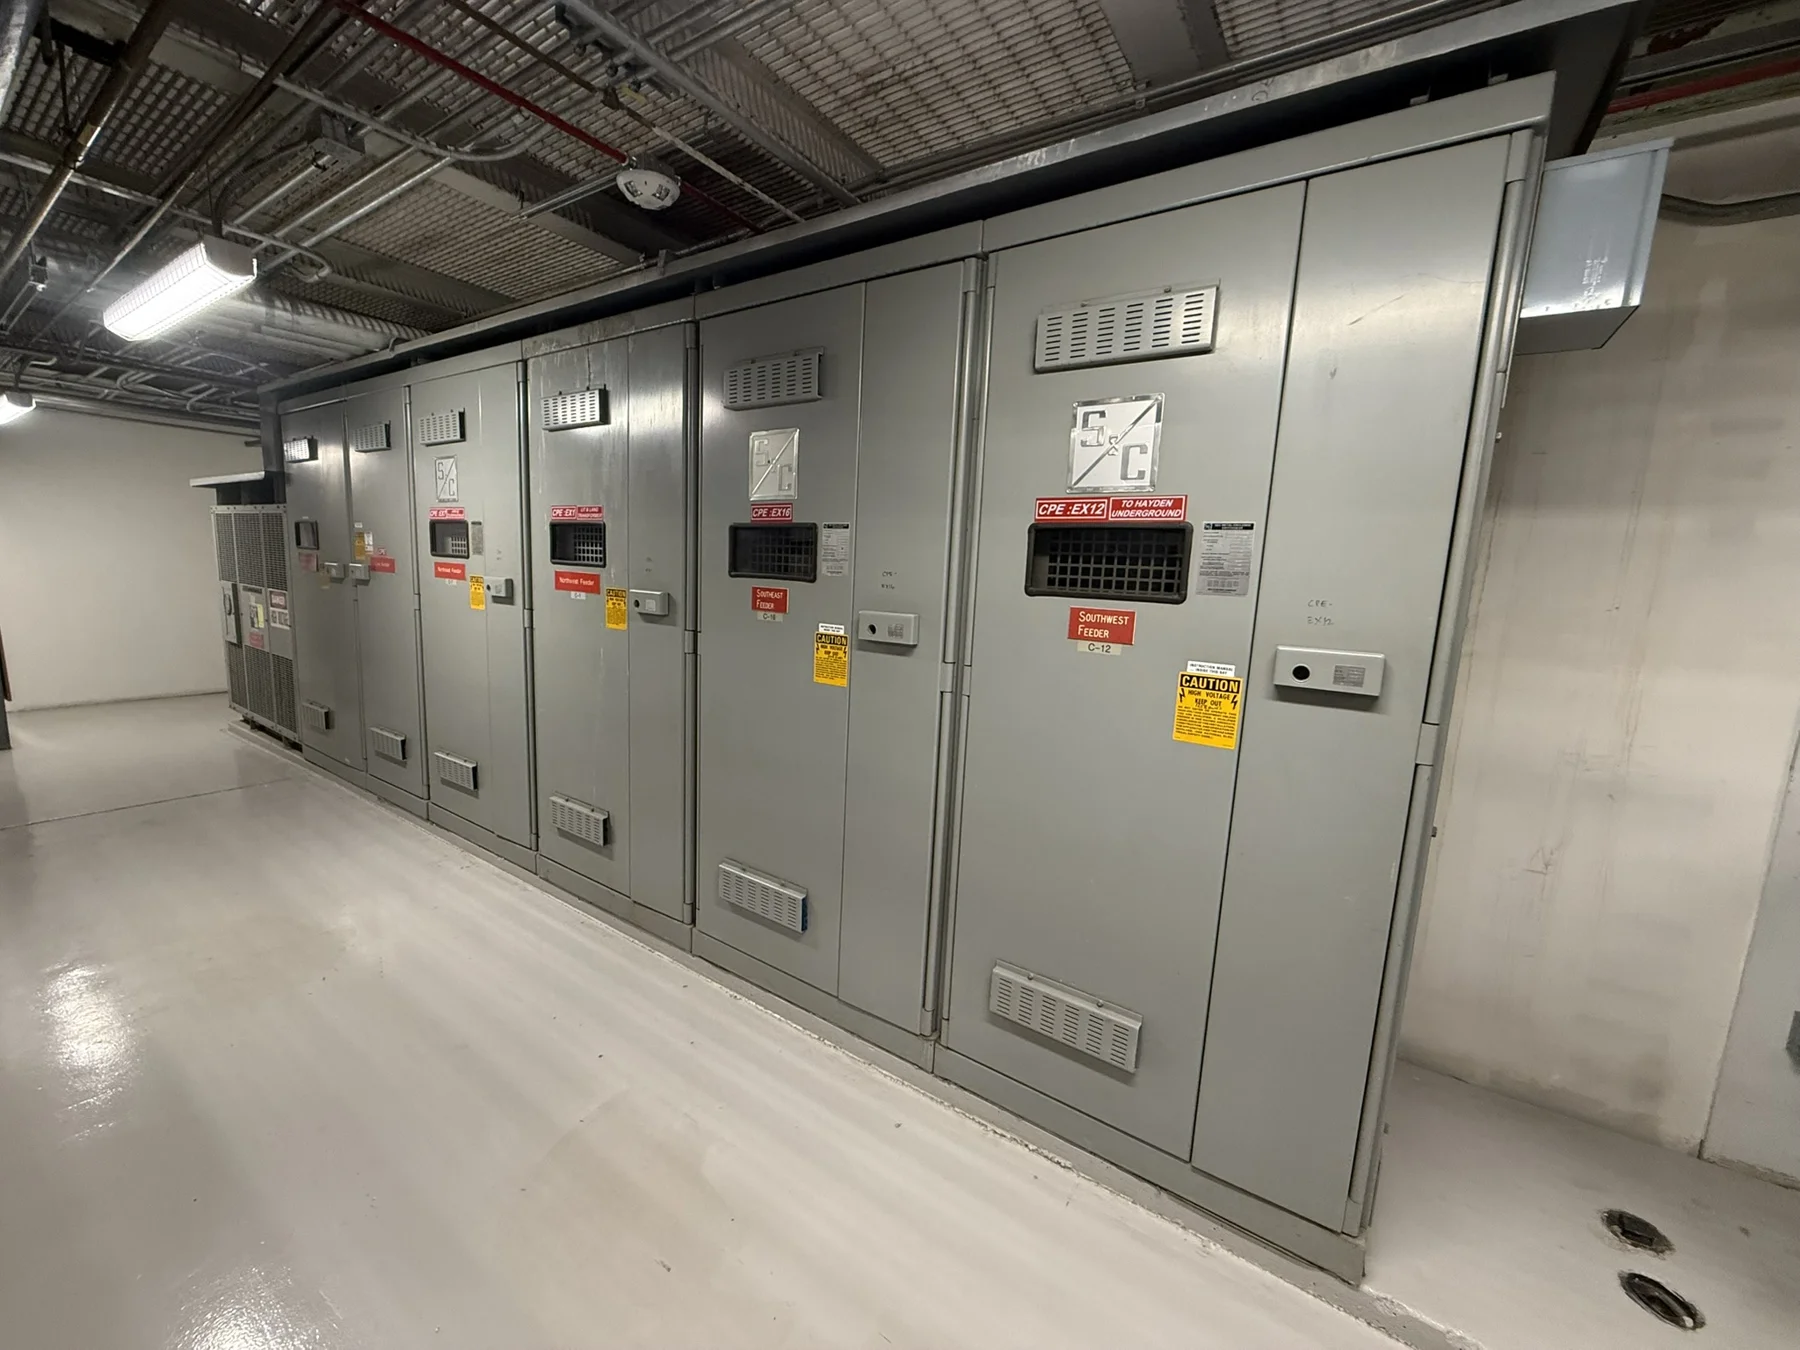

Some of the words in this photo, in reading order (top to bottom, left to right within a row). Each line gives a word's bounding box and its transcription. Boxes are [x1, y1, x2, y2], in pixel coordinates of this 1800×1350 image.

[1121, 499, 1134, 508] TO
[1134, 499, 1174, 508] HAYDEN
[752, 508, 768, 517] CPE
[1039, 503, 1066, 515] CPE
[1067, 503, 1106, 515] :EX12
[1111, 509, 1182, 518] UNDERGROUND
[817, 634, 847, 646] CAUTION
[1088, 643, 1111, 653] C-12
[1182, 675, 1238, 693] CAUTION
[1206, 691, 1230, 701] VOLTAGE
